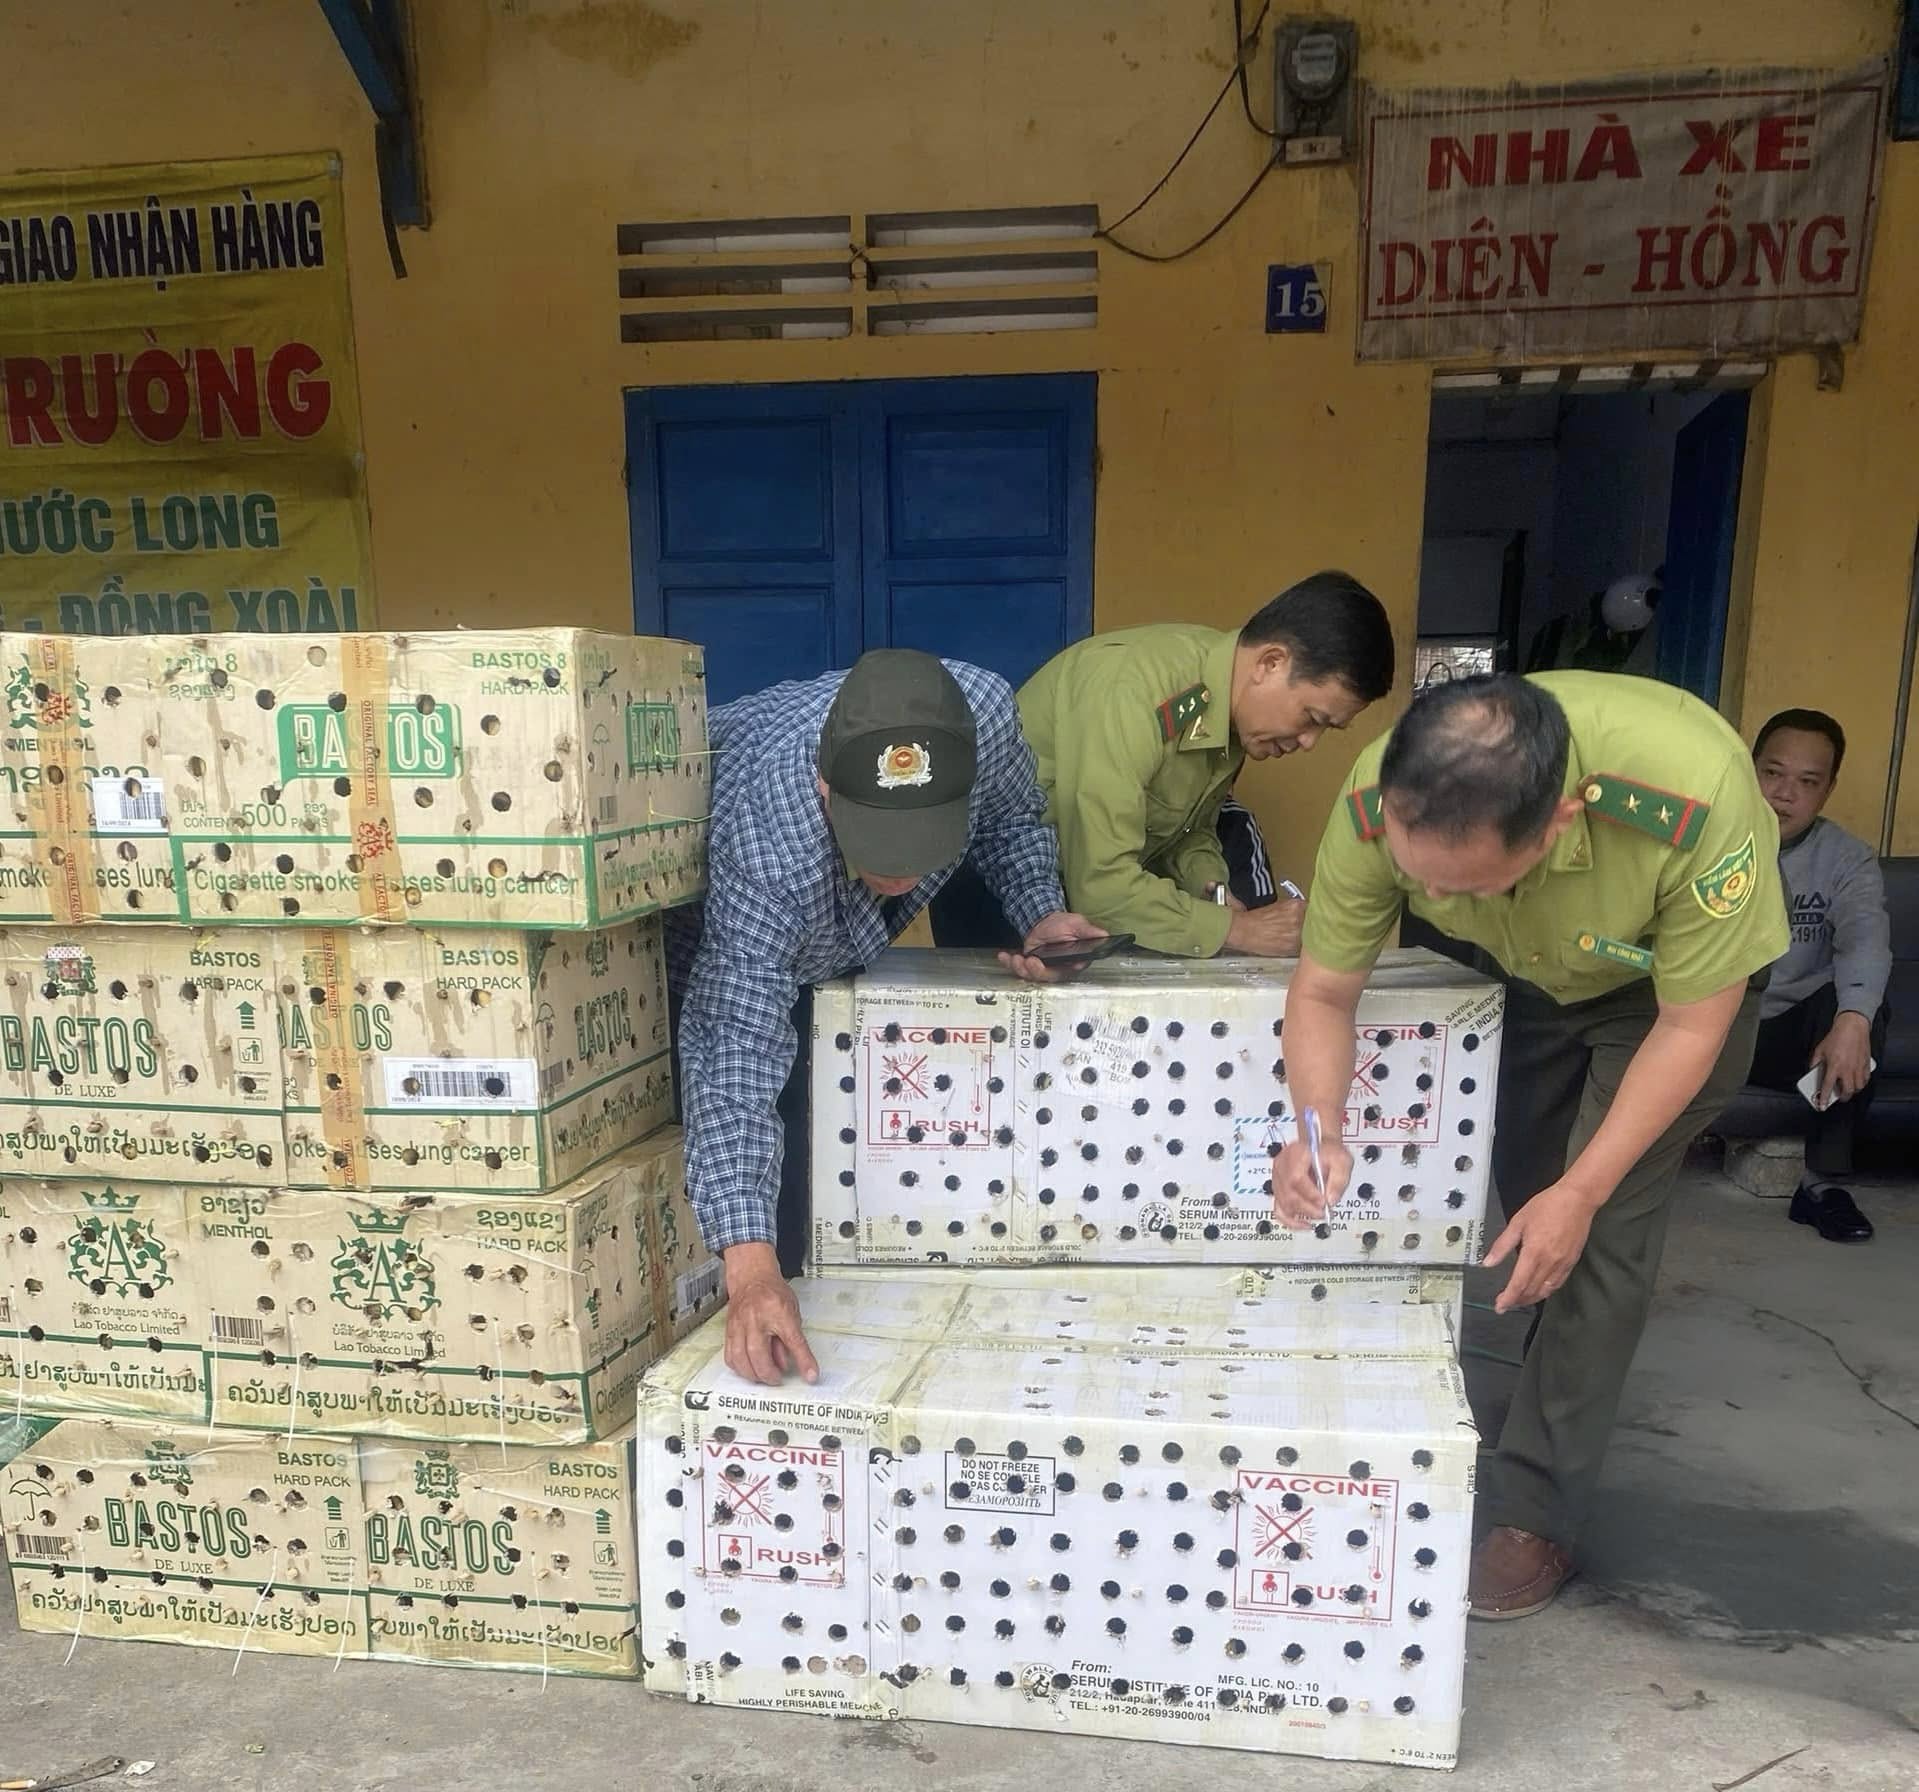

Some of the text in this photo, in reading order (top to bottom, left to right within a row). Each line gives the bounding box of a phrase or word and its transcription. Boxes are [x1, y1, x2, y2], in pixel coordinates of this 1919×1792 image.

[1428, 113, 1817, 191] NHÀ XE
[88, 195, 201, 291] NHẬN
[211, 189, 325, 272] HÀNG
[1378, 183, 1851, 306] DIÊN - HỒNG
[1274, 281, 1327, 317] 15
[0, 488, 281, 554] ƯỚC LONG
[60, 576, 212, 634] ĐỒNG
[229, 577, 359, 633] XOÀI
[472, 652, 568, 669] BASTOS 8
[481, 681, 570, 696] HARD PACK
[242, 803, 287, 828] 500
[194, 868, 286, 894] Cigarette
[293, 867, 361, 891] smoke
[451, 875, 496, 897] lung
[190, 951, 261, 968] BASTOS
[442, 949, 519, 966] BASTOS
[227, 977, 264, 992] PACK
[436, 976, 522, 990] HARD PACK
[1, 1014, 157, 1078] BASTOS
[80, 1084, 117, 1098] LUXE
[915, 1119, 979, 1132] RUSH
[1363, 1117, 1429, 1130] RUSH
[1369, 1199, 1381, 1208] 10
[1179, 1210, 1219, 1220] SERUM
[202, 1224, 273, 1240] MENTHOL
[527, 1239, 568, 1253] PACK
[74, 1318, 181, 1336] Lao Tobacco Limited
[334, 1341, 446, 1358] Lao Tobacco Limed
[718, 1395, 863, 1421] SERUM INSTITUTE OF INDIA
[795, 1422, 830, 1432] STORAGE
[278, 1452, 347, 1468] BASTOS
[705, 1444, 839, 1468] VACCINE
[549, 1462, 617, 1478] BASTOS
[961, 1458, 1040, 1473] DO NOT FREEZE
[274, 1473, 351, 1488] HARD PACK
[960, 1470, 976, 1480] NO
[978, 1471, 991, 1481] SE
[544, 1485, 620, 1500] HARD PACK
[1243, 1474, 1393, 1498] VACCINE
[105, 1497, 251, 1558] BASTOS
[368, 1512, 516, 1576] BASTOS
[154, 1558, 214, 1574] DE LUXE
[757, 1548, 832, 1567] RUSH
[414, 1577, 475, 1592] DE LUXE
[1071, 1659, 1113, 1674] From:
[1217, 1674, 1320, 1692] MFG. LIC. NO.: 10
[785, 1688, 845, 1699] LIFE SAVING
[1194, 1685, 1213, 1697] OF
[1292, 1696, 1323, 1708] LTD.
[738, 1697, 838, 1710] HIGHLY PERISHABLE
[1069, 1700, 1212, 1722] TEL.: +91-20-26993900/04
